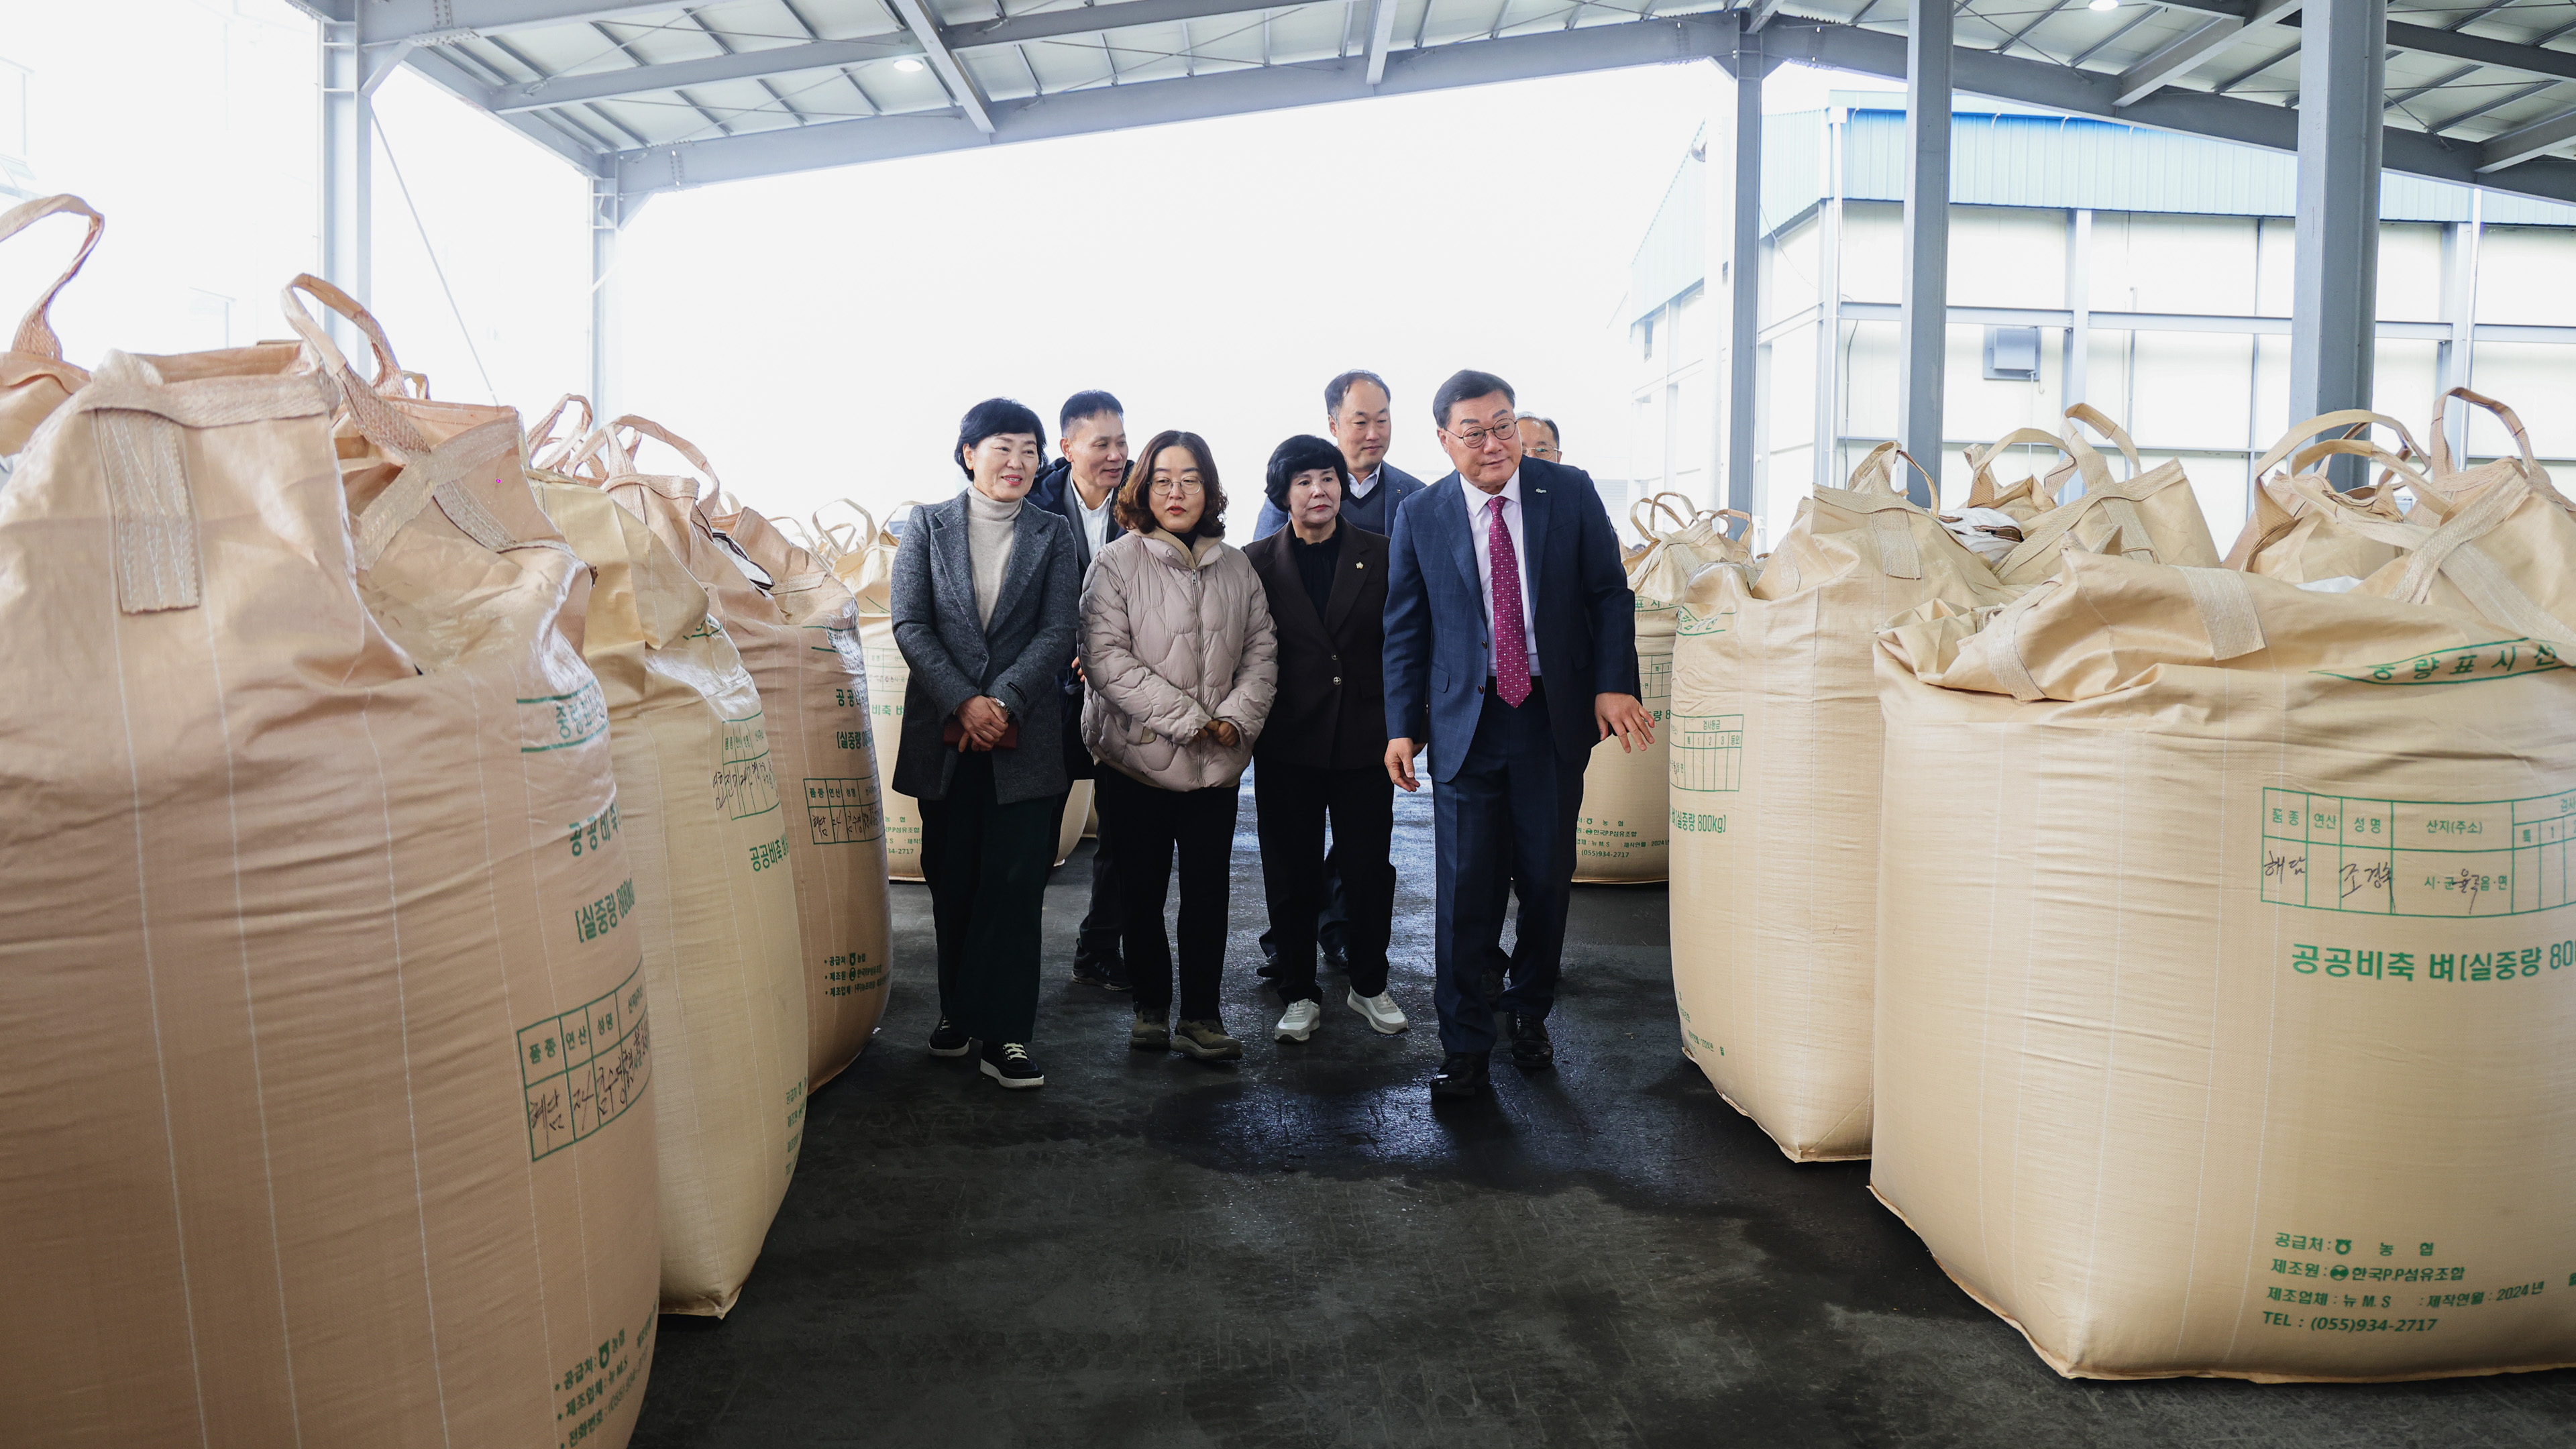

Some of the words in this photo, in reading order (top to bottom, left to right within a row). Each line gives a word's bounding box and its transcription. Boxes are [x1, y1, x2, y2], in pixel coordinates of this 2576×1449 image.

[2314, 812, 2337, 829] 연산
[2354, 816, 2381, 834] 성명
[2426, 820, 2483, 835] 산지(주소)
[749, 839, 784, 872] 공공비축
[1581, 849, 1629, 858] (055)934-2717
[575, 893, 618, 943] [실중량
[2292, 943, 2415, 982] 공공비축
[2429, 947, 2542, 982] 벼[실중량
[2550, 938, 2576, 970] 80
[2352, 1267, 2465, 1282] 한국P.P섬유조합
[2310, 1316, 2438, 1333] (055)934-2717
